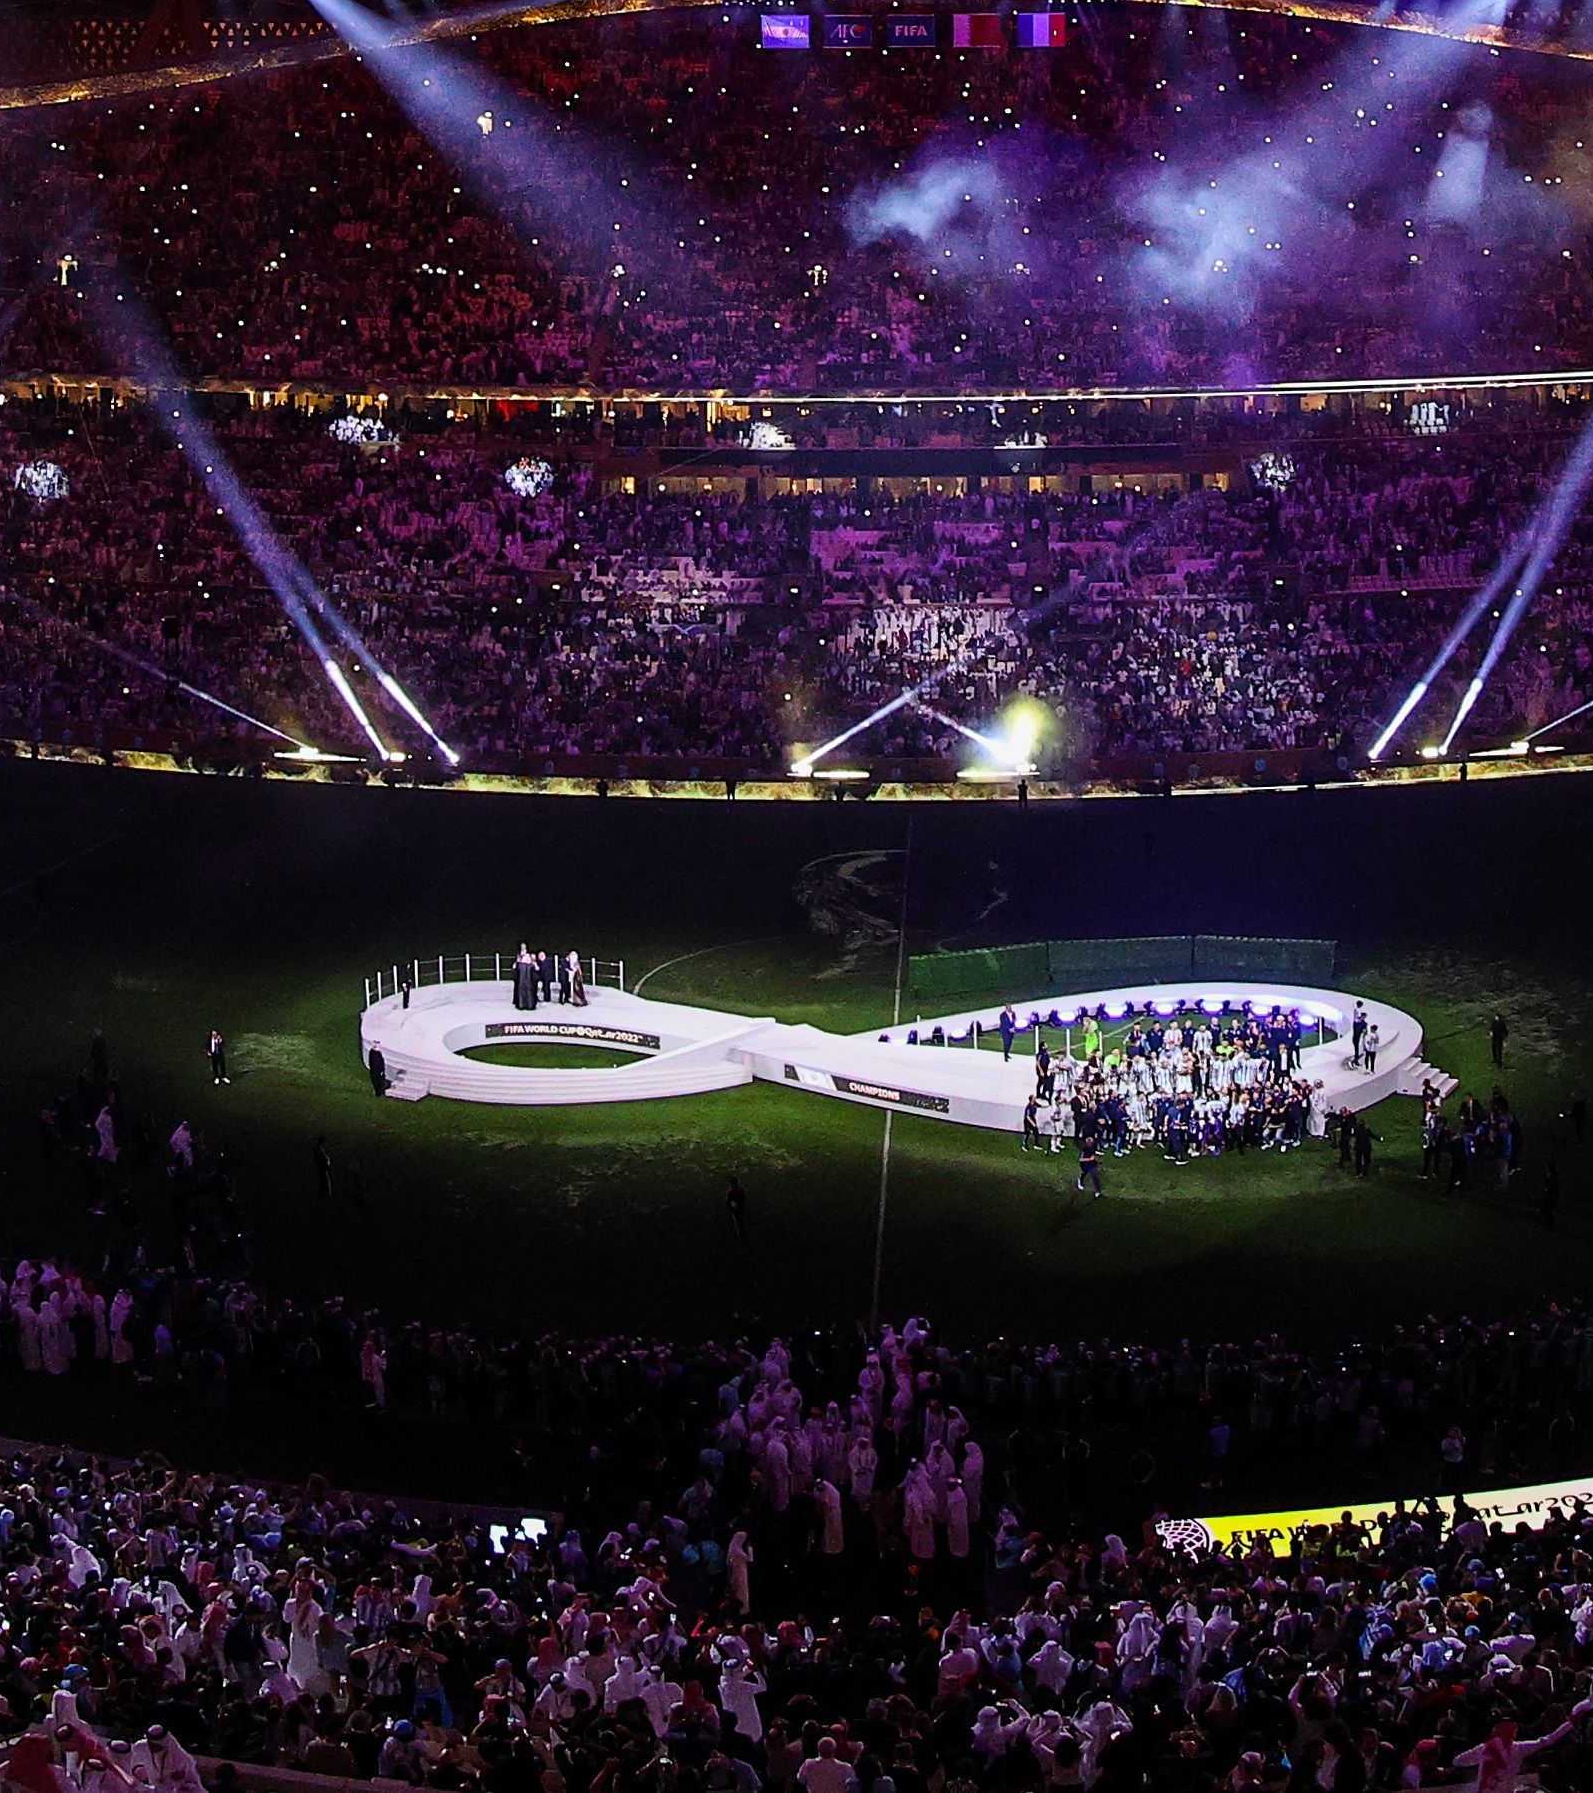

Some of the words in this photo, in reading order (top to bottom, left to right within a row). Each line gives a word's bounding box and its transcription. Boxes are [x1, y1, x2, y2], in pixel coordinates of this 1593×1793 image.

[830, 24, 864, 39] AFC
[895, 25, 928, 37] FIFA
[504, 1025, 525, 1034] FIFA
[524, 1025, 558, 1034] WORLD
[849, 1082, 901, 1102] CHAMPIONS
